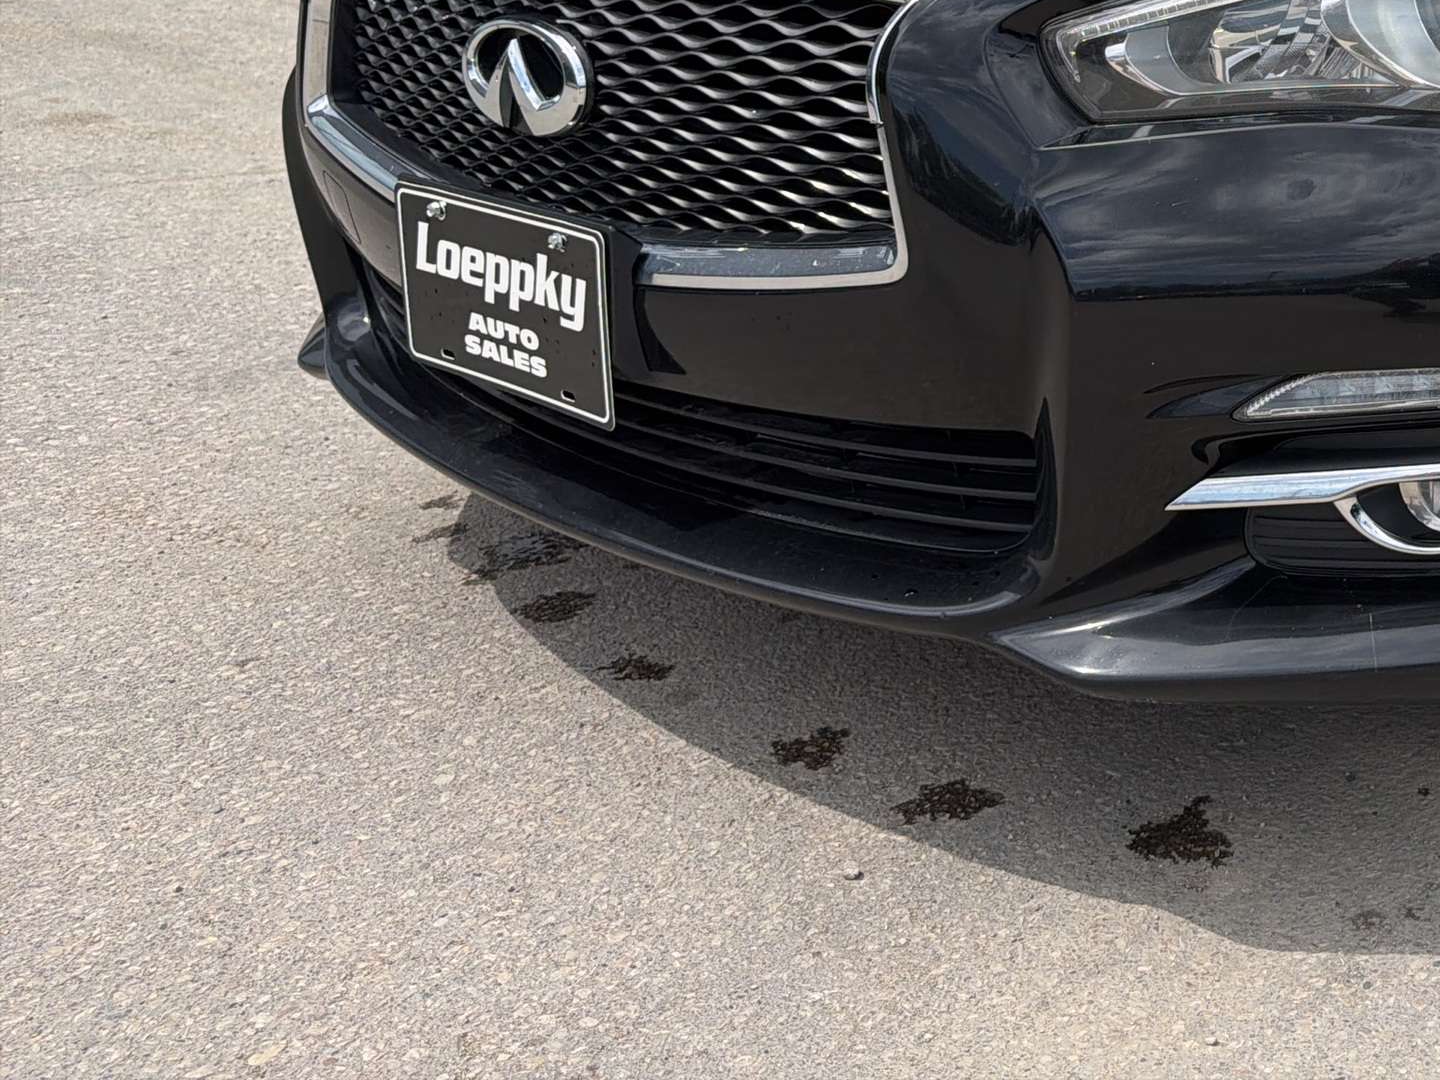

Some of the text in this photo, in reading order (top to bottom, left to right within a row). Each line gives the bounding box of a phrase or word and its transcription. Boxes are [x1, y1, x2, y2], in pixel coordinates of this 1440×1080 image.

[415, 221, 587, 332] Loeppky
[468, 311, 540, 351] AUTO
[464, 334, 548, 378] SALES
